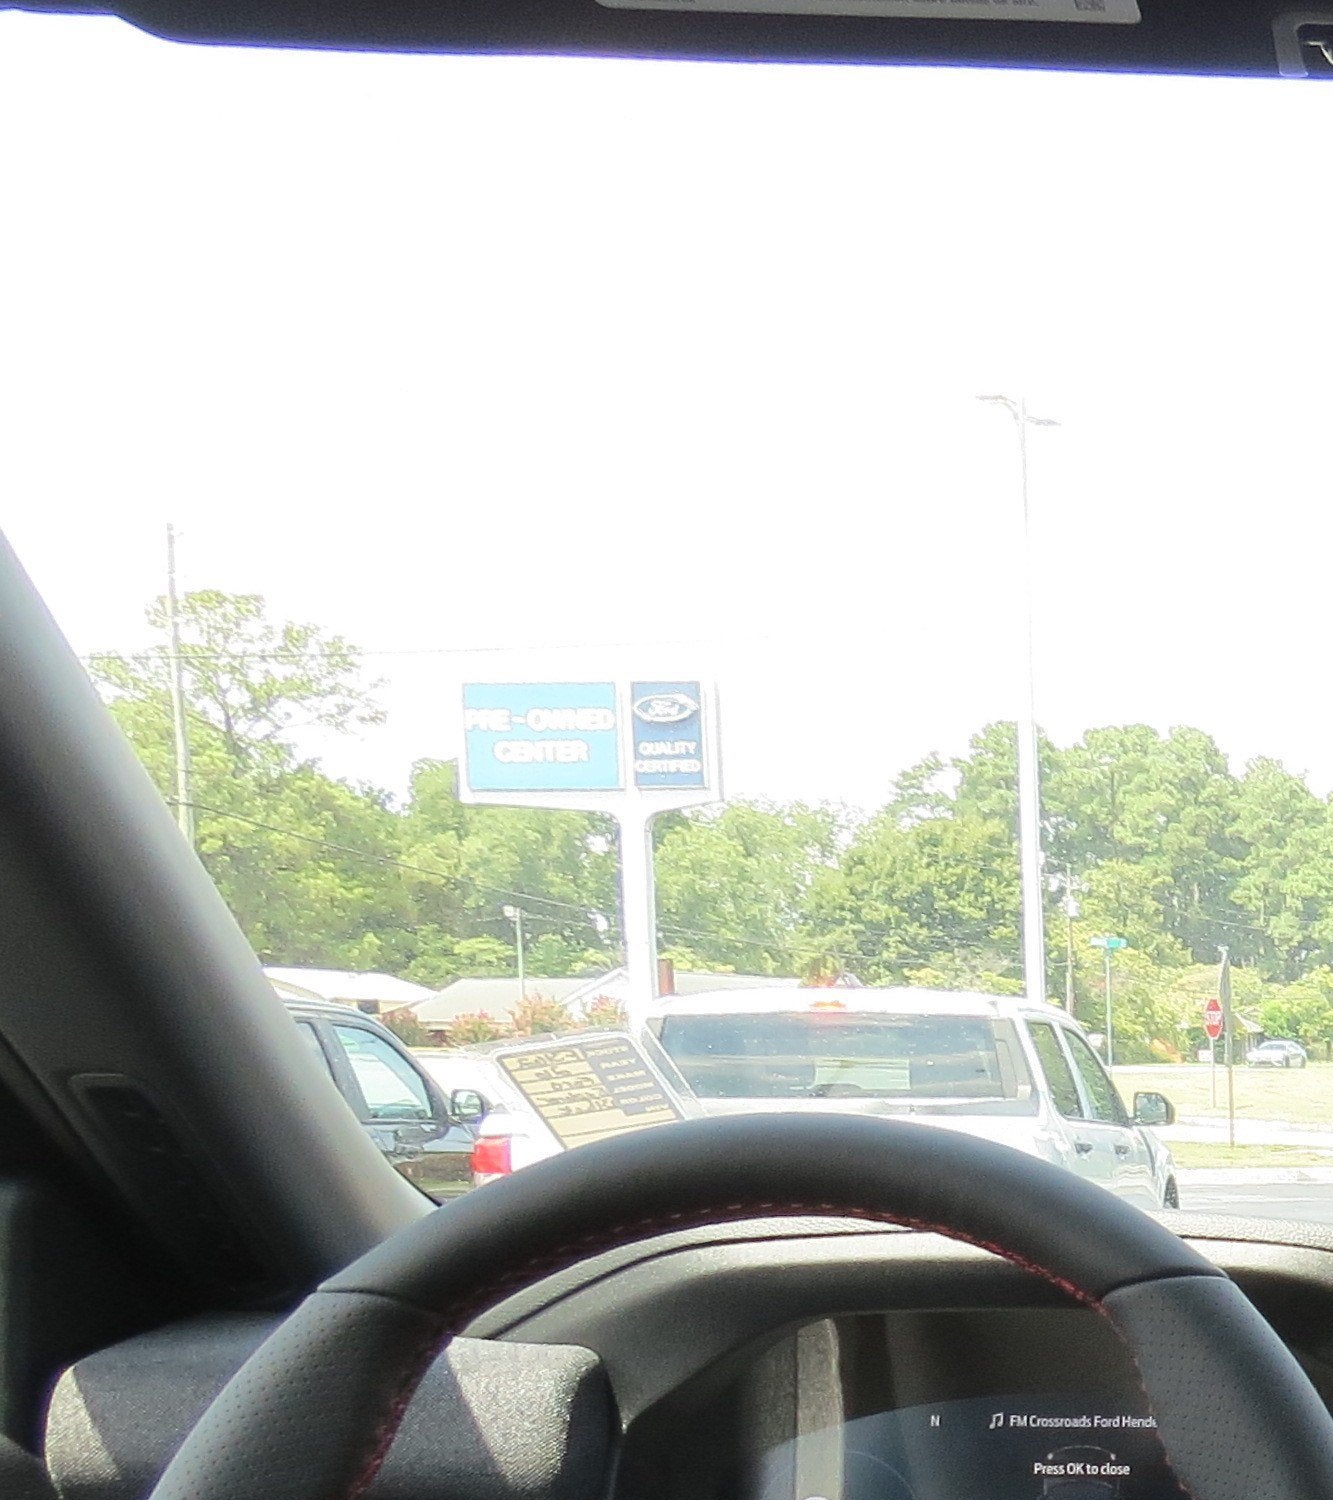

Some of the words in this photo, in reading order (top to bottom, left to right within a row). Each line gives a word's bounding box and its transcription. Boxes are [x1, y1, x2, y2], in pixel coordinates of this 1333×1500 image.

[464, 707, 616, 732] PRE-OWNED
[493, 739, 590, 764] CENTER
[639, 741, 697, 756] QUALITY
[635, 759, 701, 774] CERTIFIED
[930, 1414, 941, 1427] N
[1009, 1415, 1027, 1427] FM
[1029, 1415, 1092, 1428] Crossroads
[1093, 1415, 1120, 1428] Ford
[1033, 1462, 1065, 1475] Press
[1066, 1462, 1084, 1475] OK
[1086, 1463, 1099, 1475] to
[1100, 1462, 1131, 1475] close
